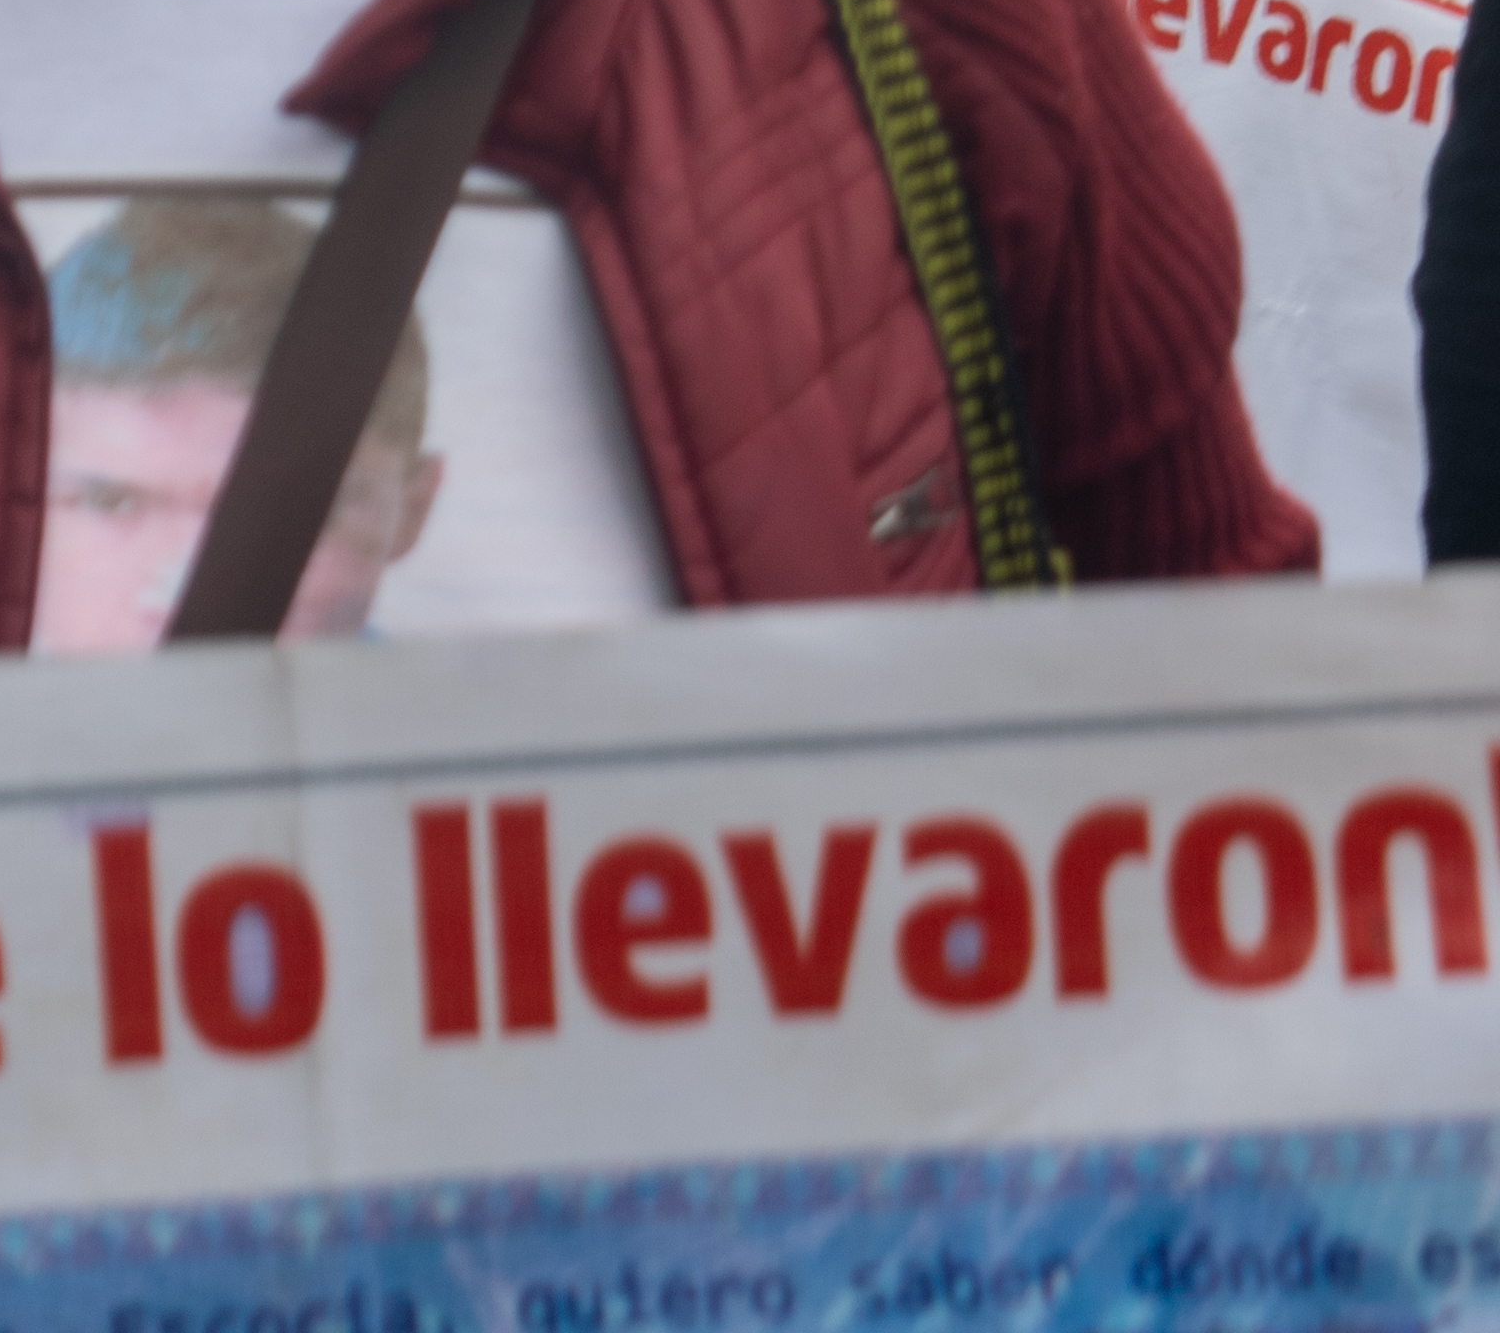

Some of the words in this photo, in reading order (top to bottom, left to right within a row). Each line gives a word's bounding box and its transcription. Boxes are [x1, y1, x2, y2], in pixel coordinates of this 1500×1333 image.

[88, 815, 328, 1069] lo
[408, 738, 1500, 1046] llevaron
[518, 1261, 797, 1333] quiero
